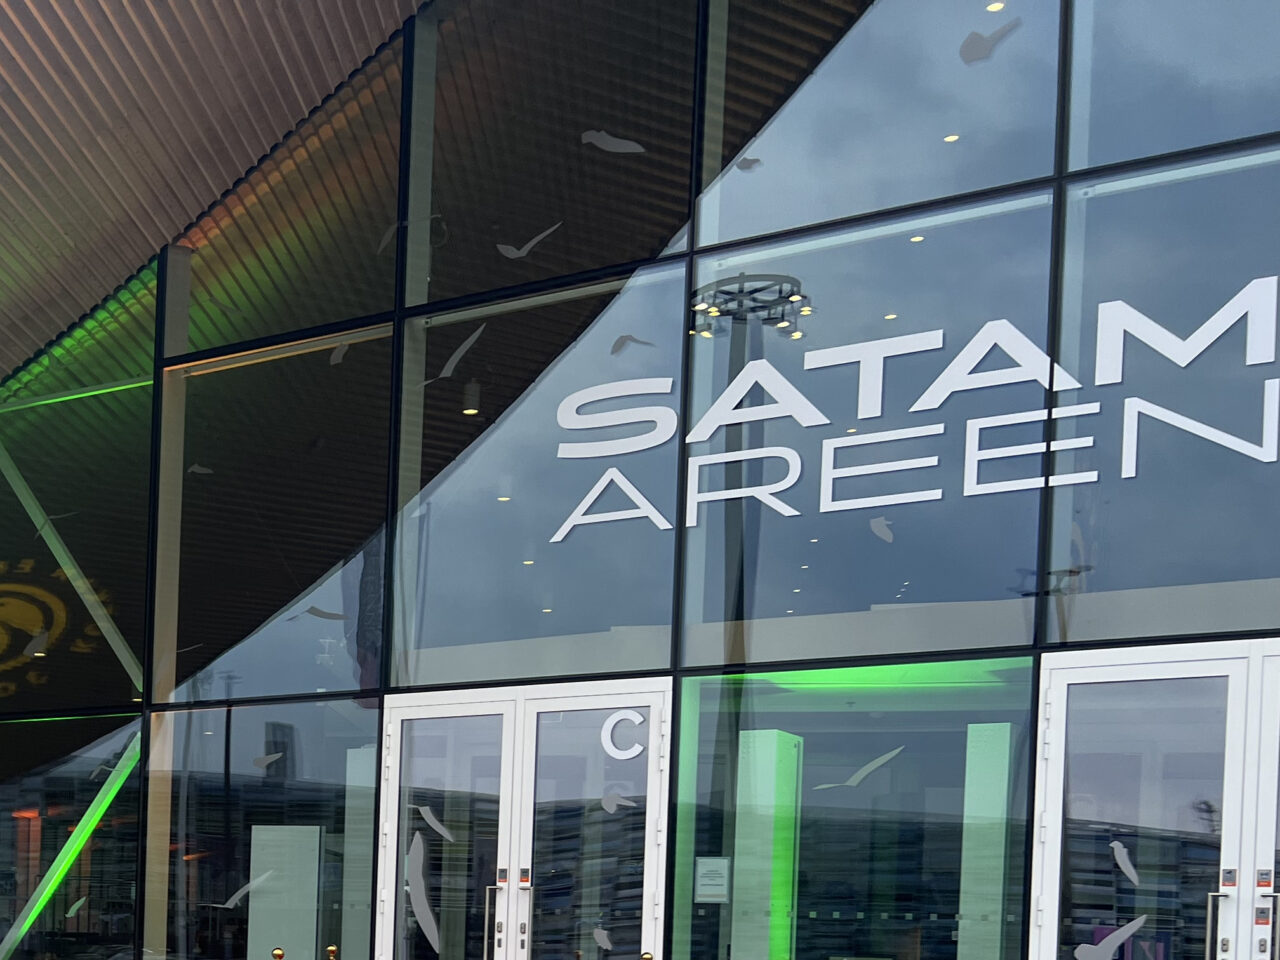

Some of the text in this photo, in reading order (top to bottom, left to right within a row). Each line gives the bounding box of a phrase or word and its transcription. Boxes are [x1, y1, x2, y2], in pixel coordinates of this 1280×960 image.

[556, 276, 1278, 459] SATAM
[549, 378, 1280, 543] AREEN
[601, 709, 644, 760] C
